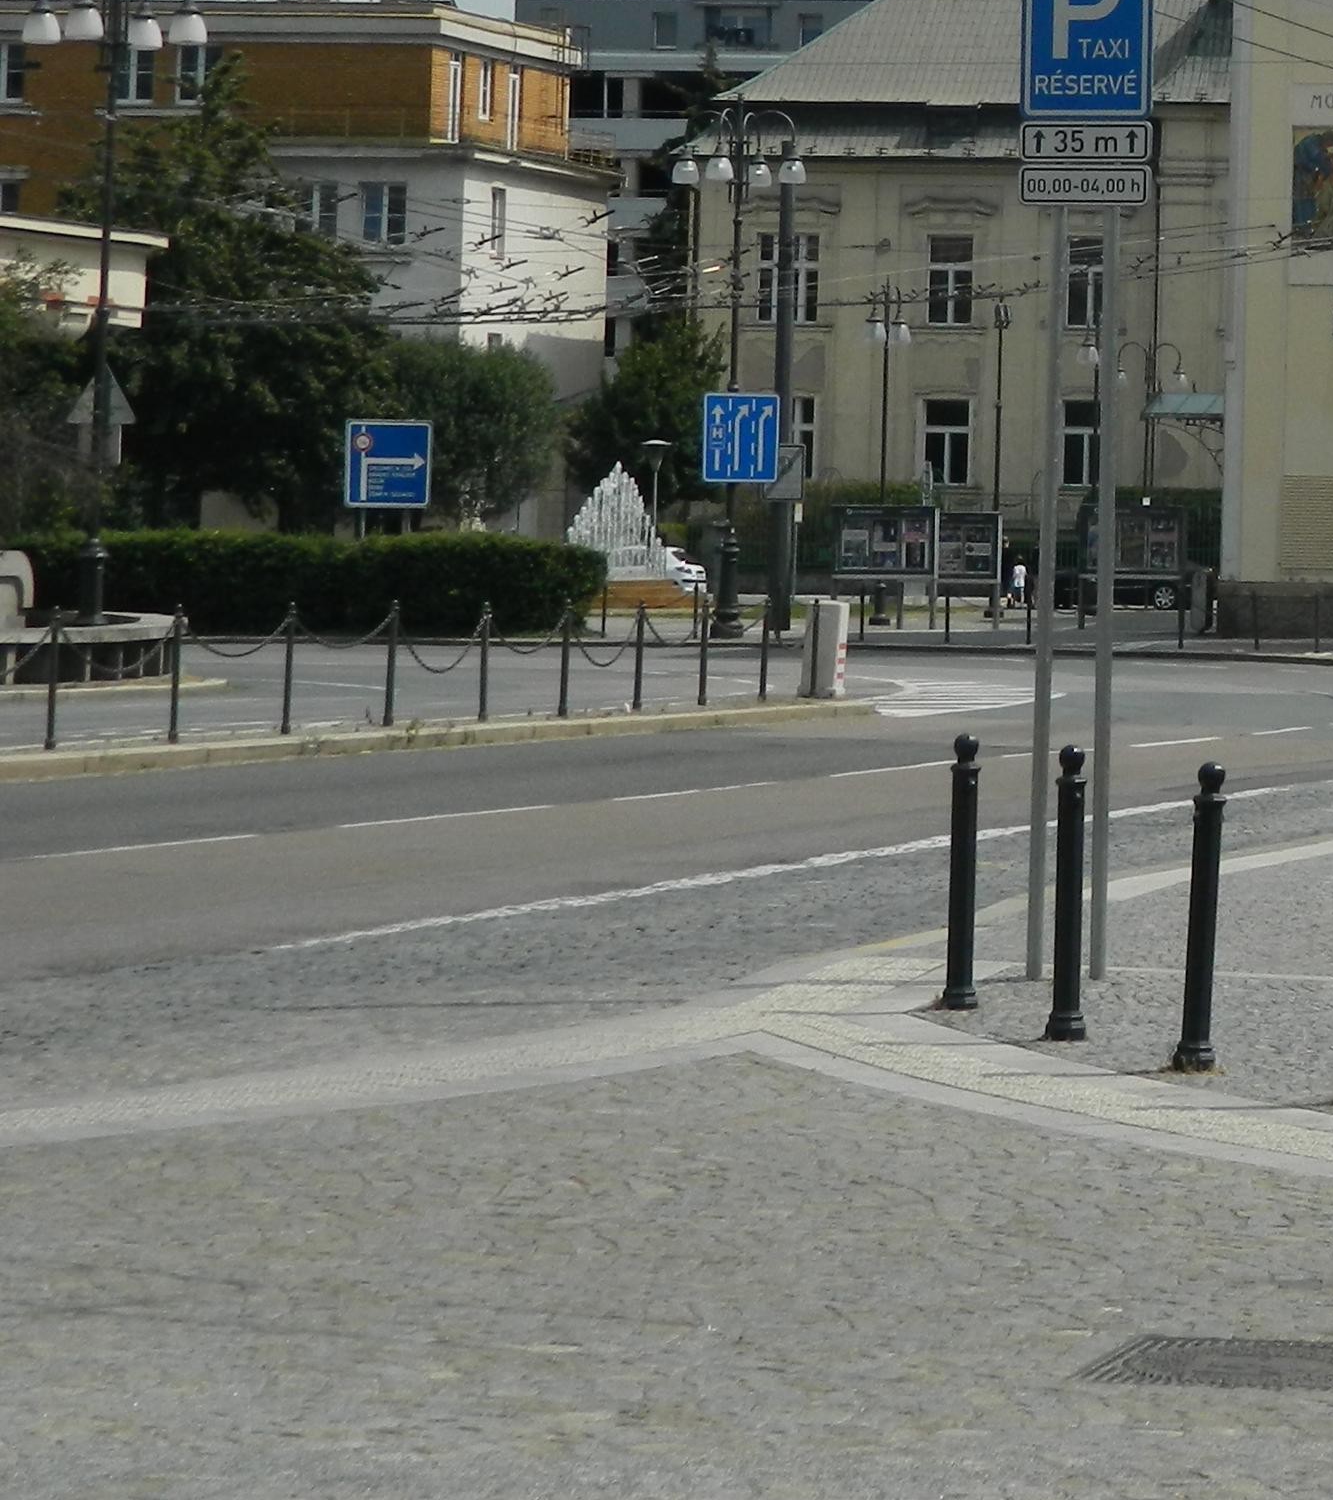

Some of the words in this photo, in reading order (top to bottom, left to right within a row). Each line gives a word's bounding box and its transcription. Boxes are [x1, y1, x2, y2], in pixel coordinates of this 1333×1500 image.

[1078, 38, 1130, 59] TAXI
[1034, 69, 1137, 95] RÉSERVÉ
[1053, 130, 1084, 153] 35
[1094, 135, 1118, 153] m
[1130, 177, 1140, 194] h
